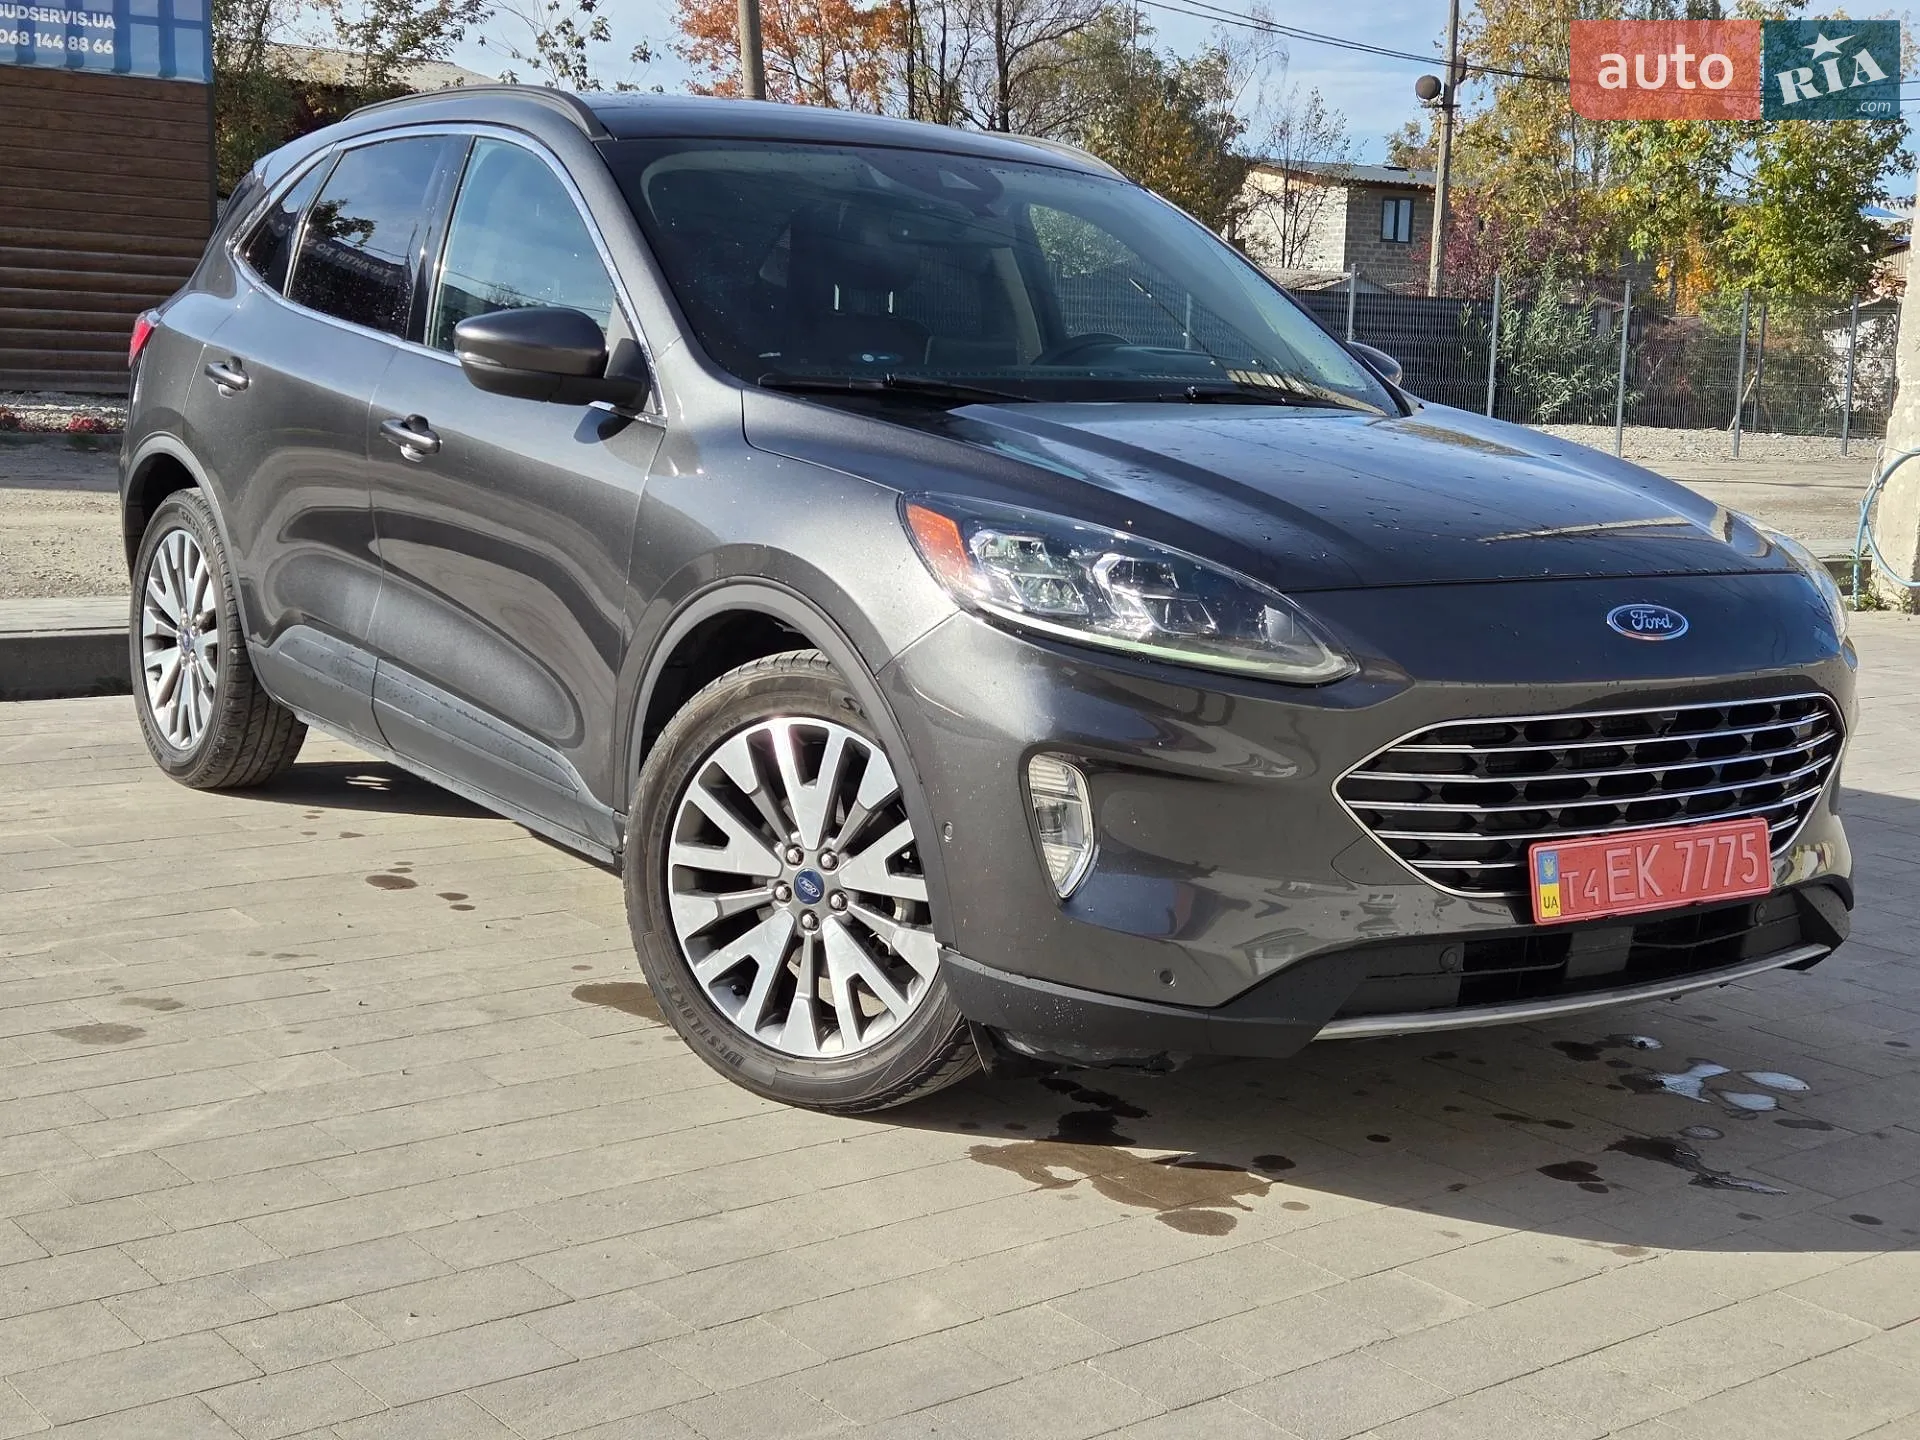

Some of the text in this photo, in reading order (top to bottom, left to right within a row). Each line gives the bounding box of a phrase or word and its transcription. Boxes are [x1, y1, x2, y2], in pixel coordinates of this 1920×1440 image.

[0, 29, 114, 54] 068 144 88 66
[1630, 610, 1673, 630] Ford
[1674, 832, 1759, 893] 7775
[1543, 896, 1559, 909] UA
